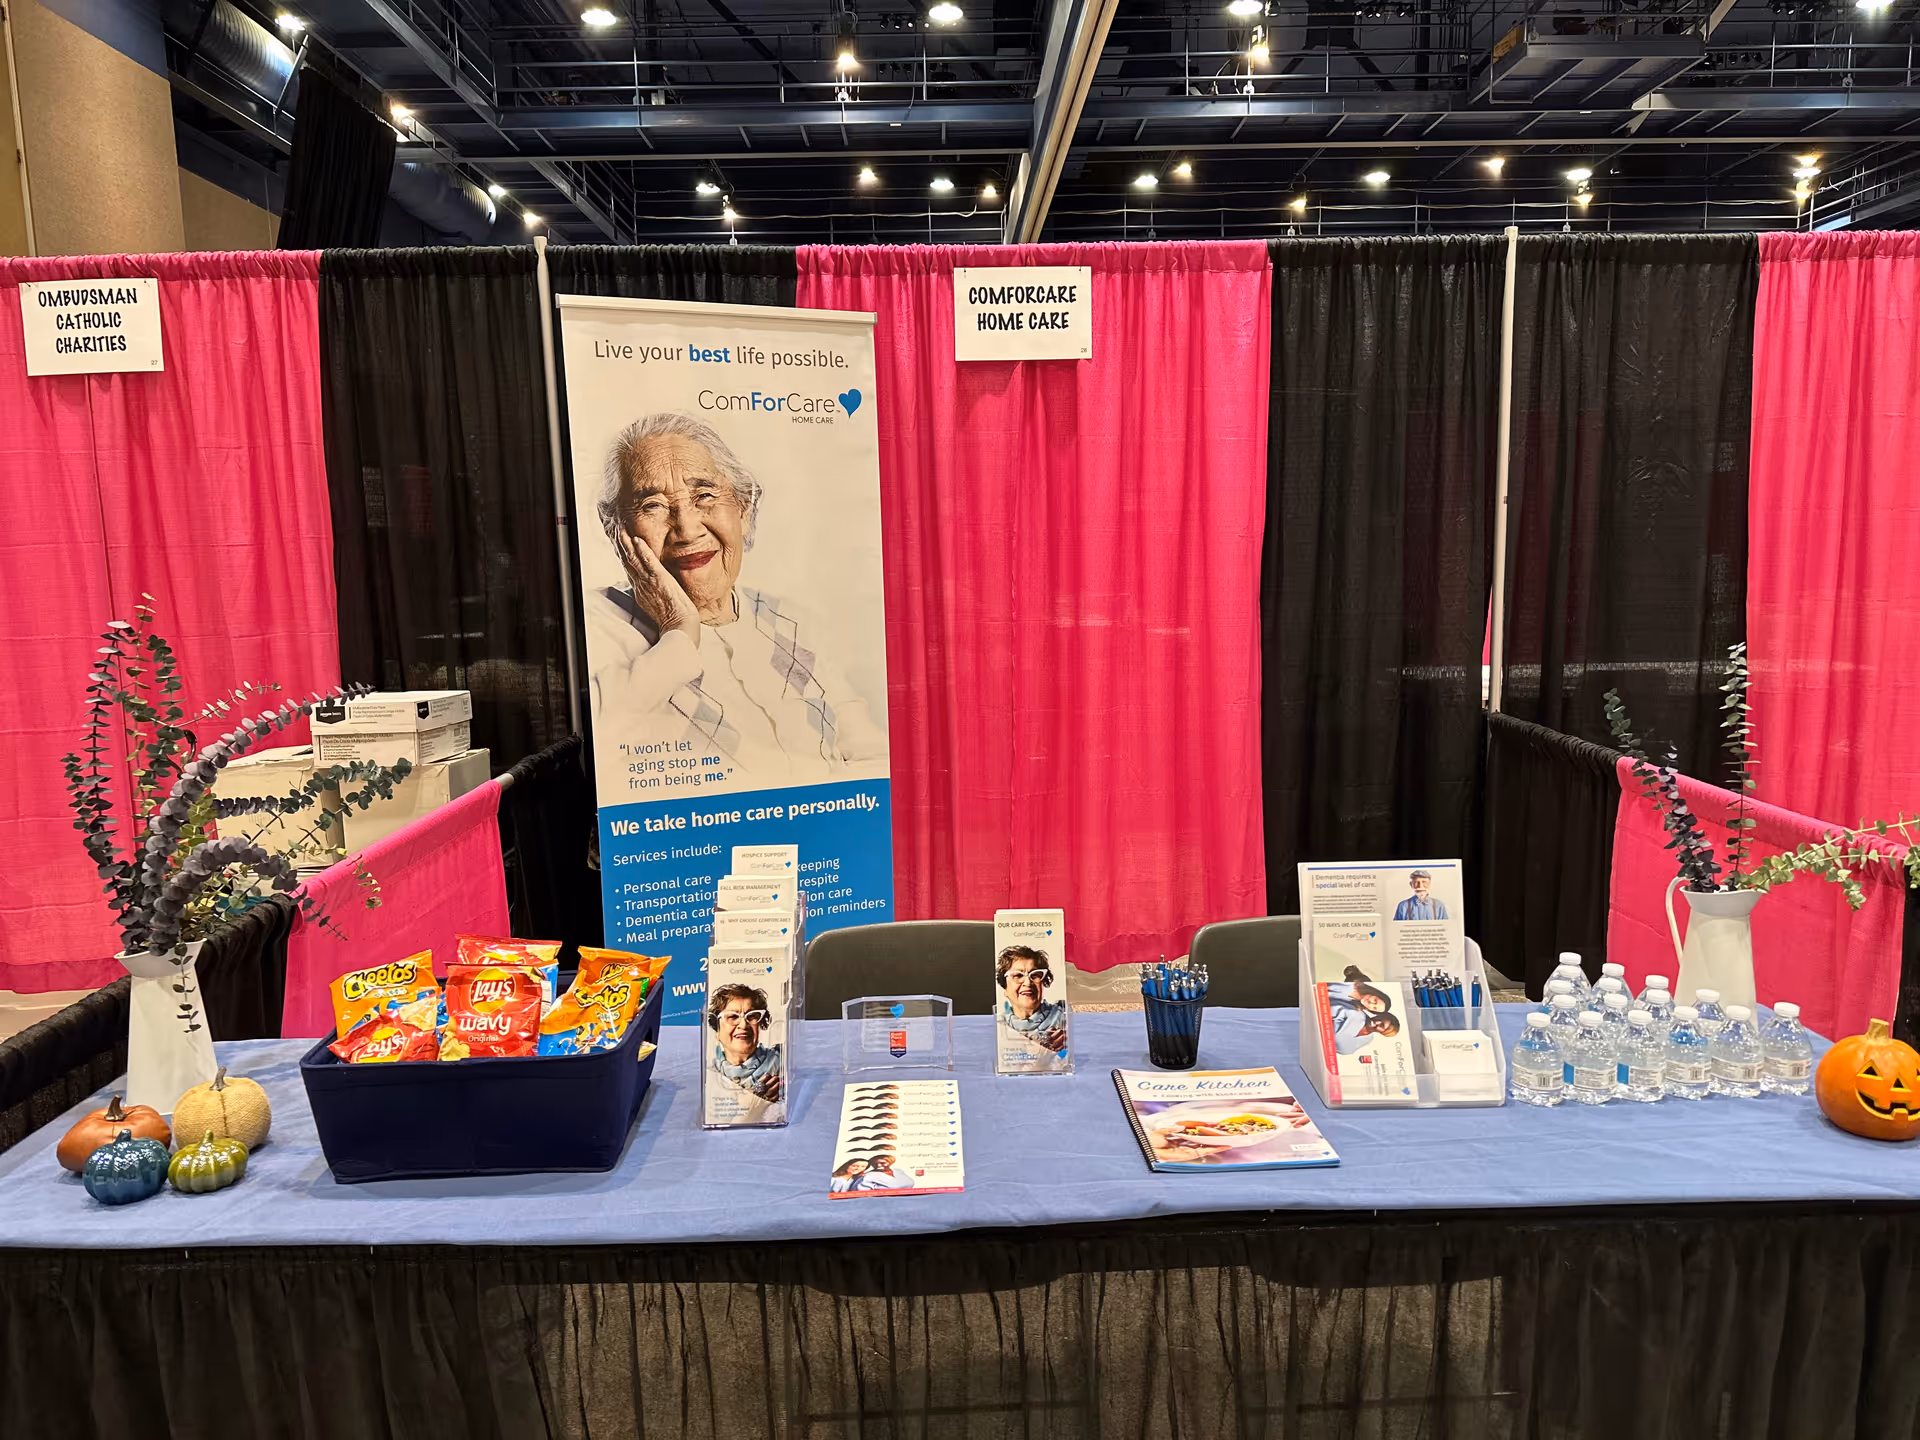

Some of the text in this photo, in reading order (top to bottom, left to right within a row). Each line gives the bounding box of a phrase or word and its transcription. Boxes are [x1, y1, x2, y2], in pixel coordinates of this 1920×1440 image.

[38, 288, 138, 307] OMBUDSMAN
[969, 285, 1077, 305] COMFORCARE
[56, 312, 122, 330] CATHOLIC
[977, 311, 1070, 331] HOME CARE
[56, 335, 127, 354] CHARITIES
[594, 340, 849, 369] Live your best life possible.
[698, 389, 836, 413] ComForCare
[792, 416, 834, 425] HOME CARE
[675, 740, 692, 752] let
[628, 756, 720, 774] aging stop me
[628, 777, 660, 789] from
[665, 773, 701, 786] being
[610, 793, 880, 837] We take home care personally.
[613, 843, 722, 866] Services include:
[623, 875, 712, 895] Personal care
[800, 872, 839, 887] respite
[828, 887, 852, 899] care
[828, 899, 886, 915] reminders
[625, 908, 688, 928] Dementia
[627, 929, 658, 944] Meal
[344, 962, 416, 999] Cheetos
[473, 979, 513, 1002] Lay's
[459, 1012, 512, 1035] wavy
[1137, 1079, 1271, 1091] Care Kitchen
